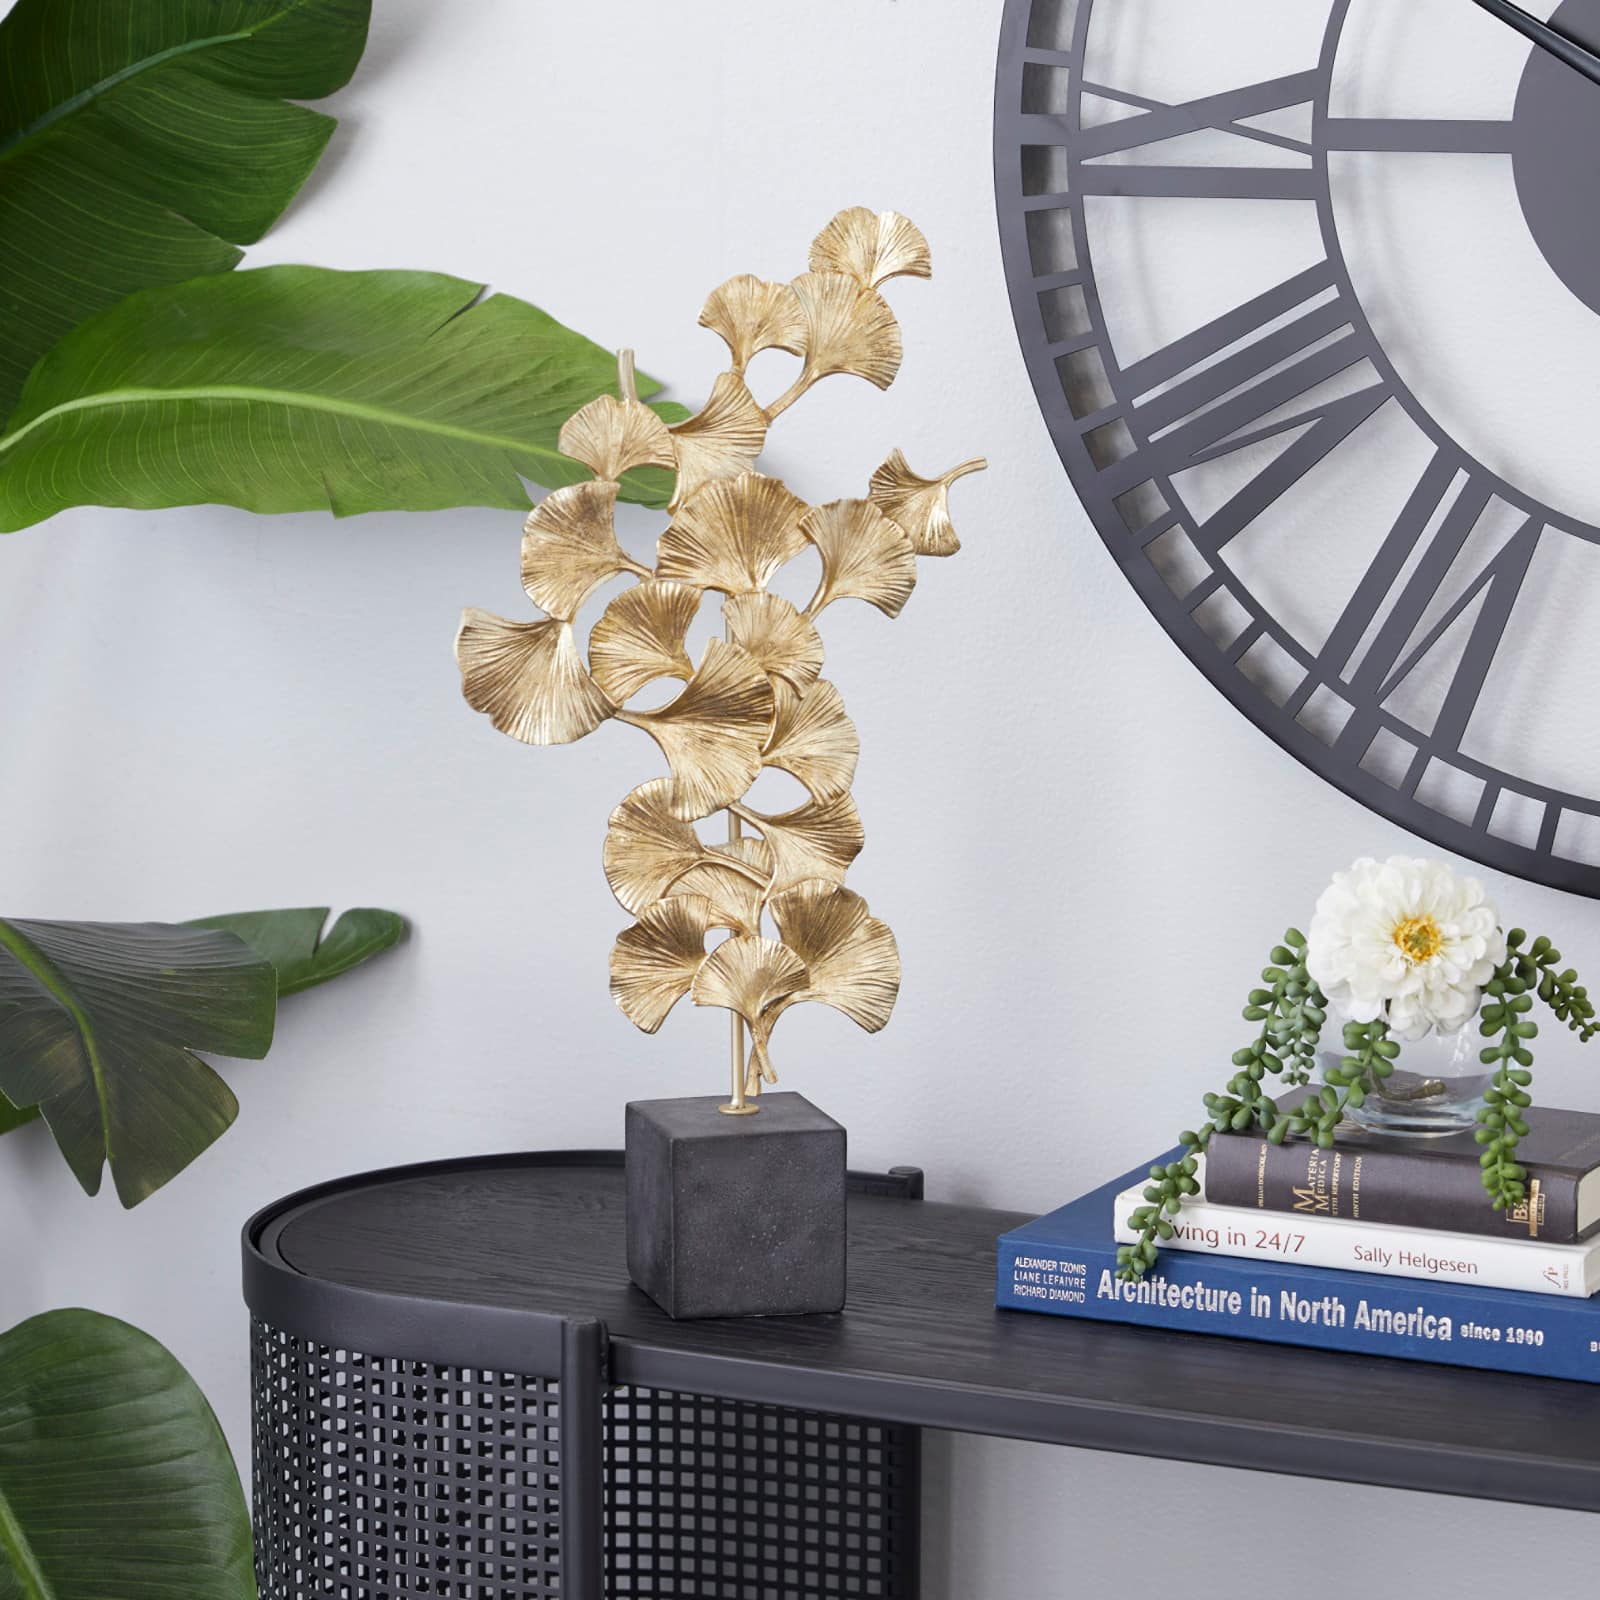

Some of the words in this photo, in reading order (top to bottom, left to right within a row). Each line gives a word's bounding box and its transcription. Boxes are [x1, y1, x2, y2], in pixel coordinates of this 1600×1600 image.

[1292, 1148, 1320, 1213] MATERIA
[1313, 1159, 1330, 1211] MEDICA
[1332, 1151, 1342, 1195] REPERTORY
[1352, 1155, 1363, 1191] EDITION
[1227, 1225, 1247, 1246] in
[1255, 1230, 1306, 1254] 24/7
[1014, 1256, 1057, 1271] ALEXANDER
[1059, 1261, 1087, 1276] TZONIS
[1353, 1245, 1393, 1268] Sally
[1399, 1251, 1479, 1275] Helgesen
[1013, 1270, 1041, 1284] LIANE
[1043, 1274, 1086, 1290] LEFAIVRE
[1013, 1284, 1047, 1299] RICHARD
[1049, 1289, 1086, 1304] DIAMOND
[1097, 1269, 1242, 1315] Architecture
[1250, 1286, 1271, 1319] in
[1280, 1290, 1346, 1328] North
[1353, 1300, 1452, 1341] America
[1460, 1322, 1501, 1342] since
